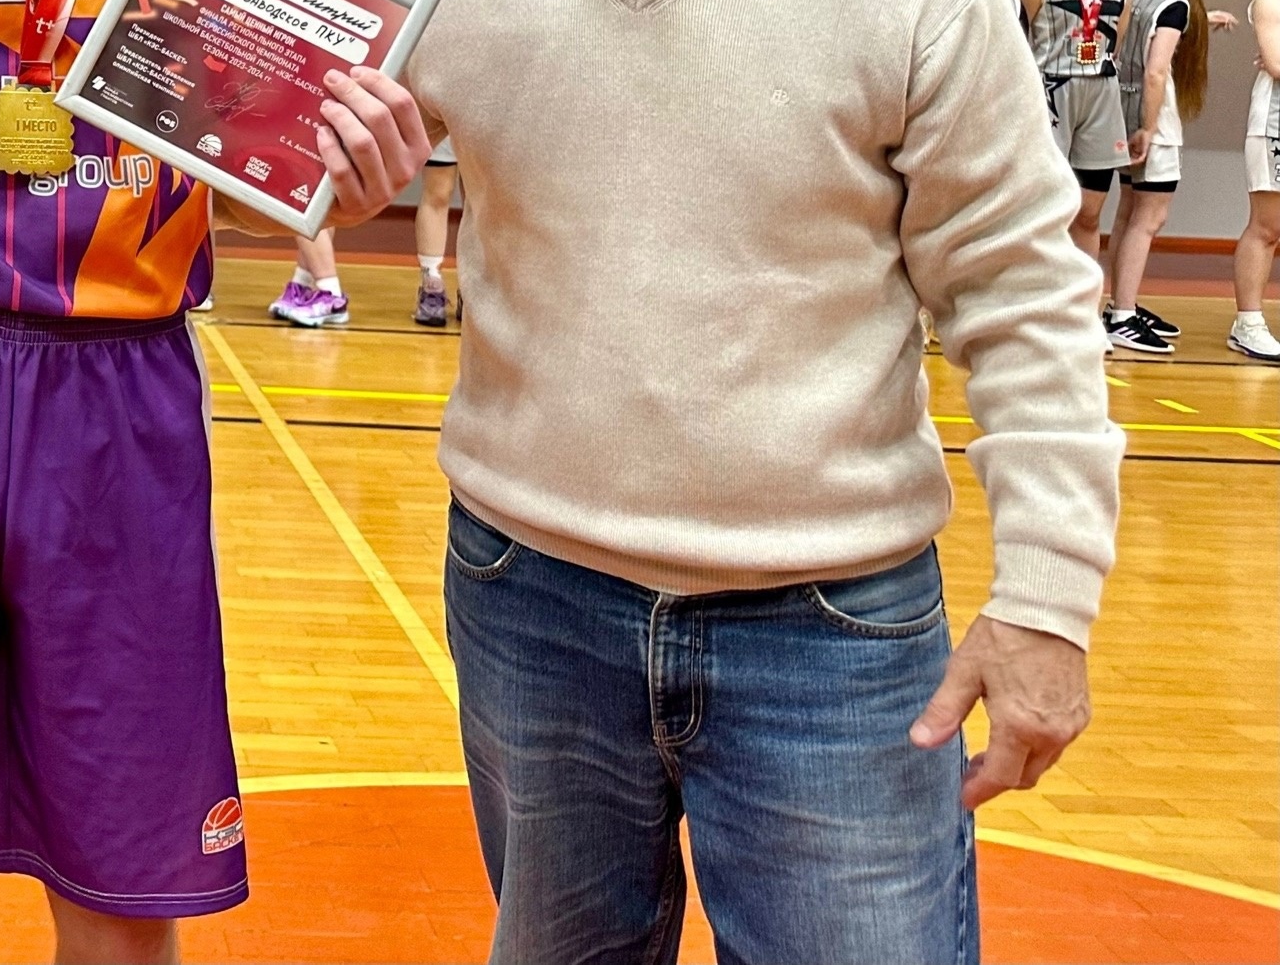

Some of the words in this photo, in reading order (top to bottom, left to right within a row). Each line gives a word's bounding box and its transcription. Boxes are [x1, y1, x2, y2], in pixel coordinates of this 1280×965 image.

[126, 30, 143, 43] ШБЛ
[195, 15, 255, 51] ВСЕРОССИЙСКОГО
[254, 44, 301, 73] ЧЕМПИОНАТА
[198, 6, 228, 26] ФИНАЛА
[227, 20, 284, 54] РЕГИОНАЛЬНОГО
[283, 48, 307, 65] ЭТАПА
[220, 3, 246, 21] САМЫЙ
[244, 16, 273, 36] ЦЕННЫЙ
[272, 30, 296, 47] ИГРОК
[162, 10, 201, 35] ШКОЛЬНОЙ
[199, 29, 257, 63] БАСКЕТБОЛЬНОЙ
[255, 58, 276, 73] ЛИГИ
[274, 67, 325, 98] «КЭС-БАСКЕТ»
[201, 42, 229, 61] СЕЗОНА
[227, 55, 264, 79] 2023-2024
[22, 119, 57, 133] МЕСТО
